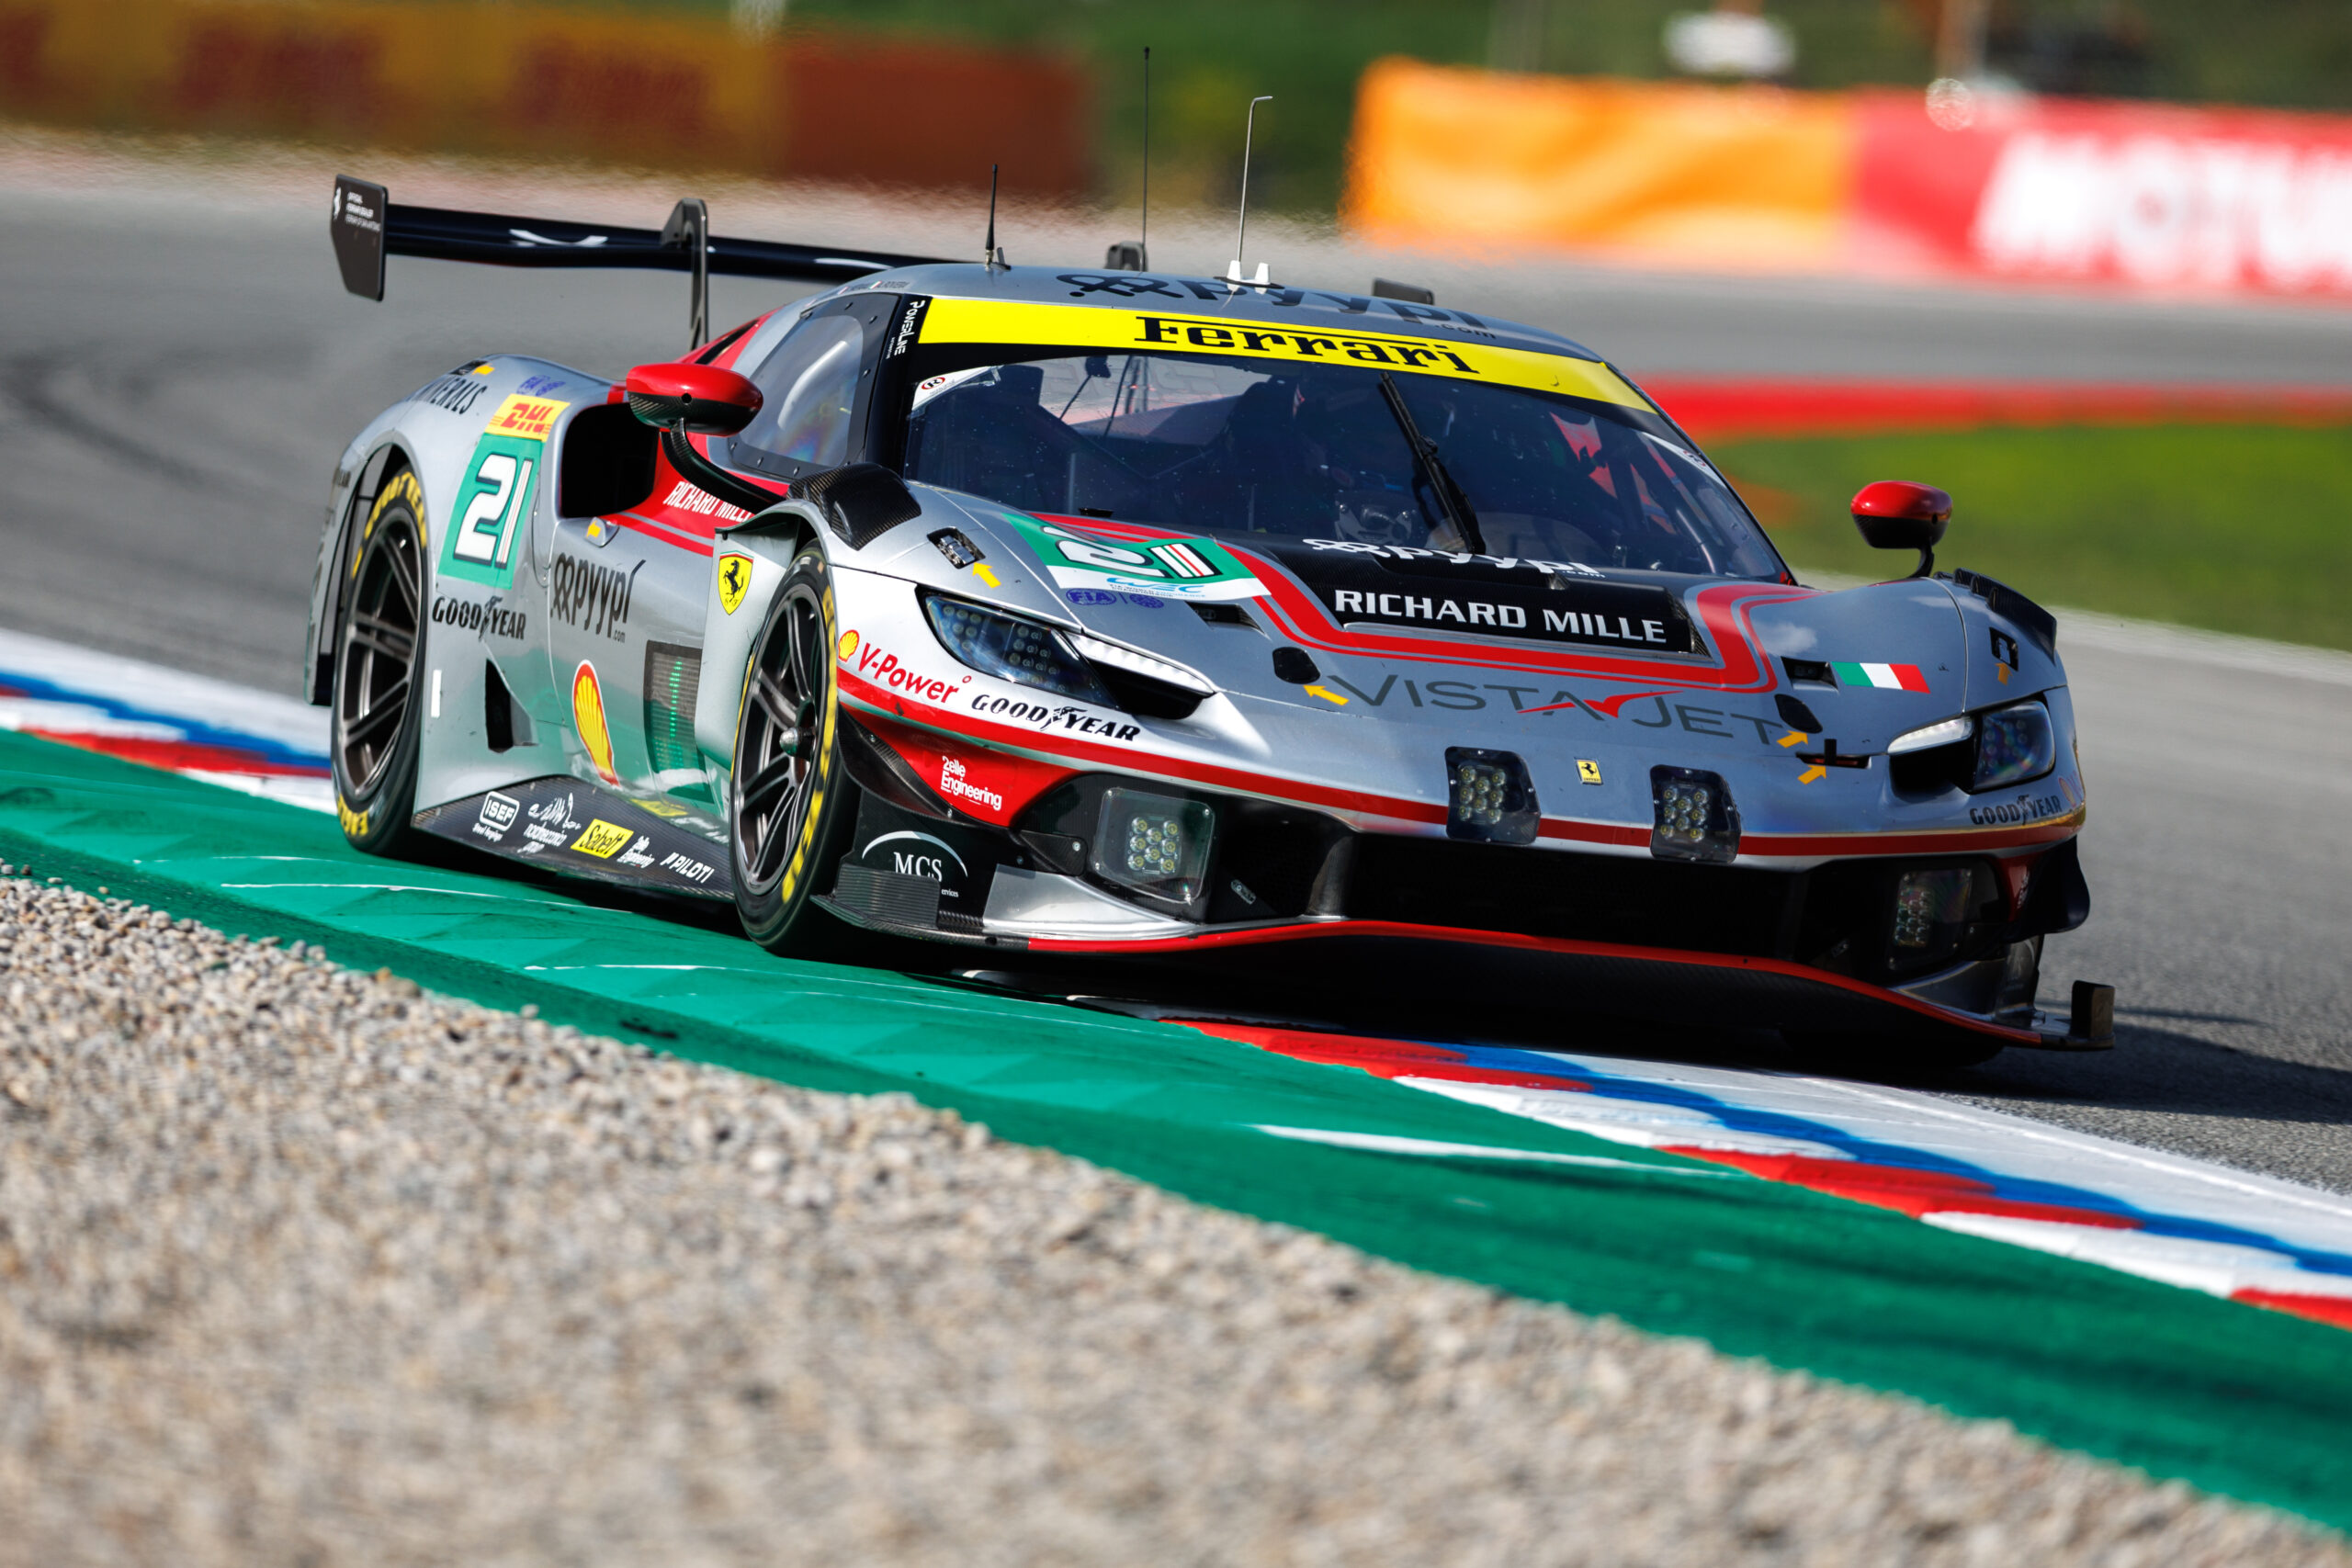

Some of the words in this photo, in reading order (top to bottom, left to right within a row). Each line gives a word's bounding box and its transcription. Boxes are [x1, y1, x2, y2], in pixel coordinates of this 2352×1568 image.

[1134, 315, 1480, 374] Ferrari
[501, 402, 554, 433] DHL
[453, 451, 534, 570] 21
[1041, 525, 1225, 580] 21
[432, 596, 526, 641] GOODYEAR
[1334, 589, 1527, 629] RICHARD
[1543, 609, 1668, 644] MILLE
[857, 642, 959, 703] V-Power
[970, 694, 1141, 742] GOODYEAR
[942, 755, 966, 778] 2elle
[941, 770, 1002, 811] Engineering
[485, 799, 514, 823] ISEF
[1969, 795, 2063, 826] GOODYEAR
[580, 824, 625, 855] Sabelt
[669, 854, 715, 884] PILOTI
[893, 852, 943, 883] MCS
[941, 887, 959, 898] ervices
